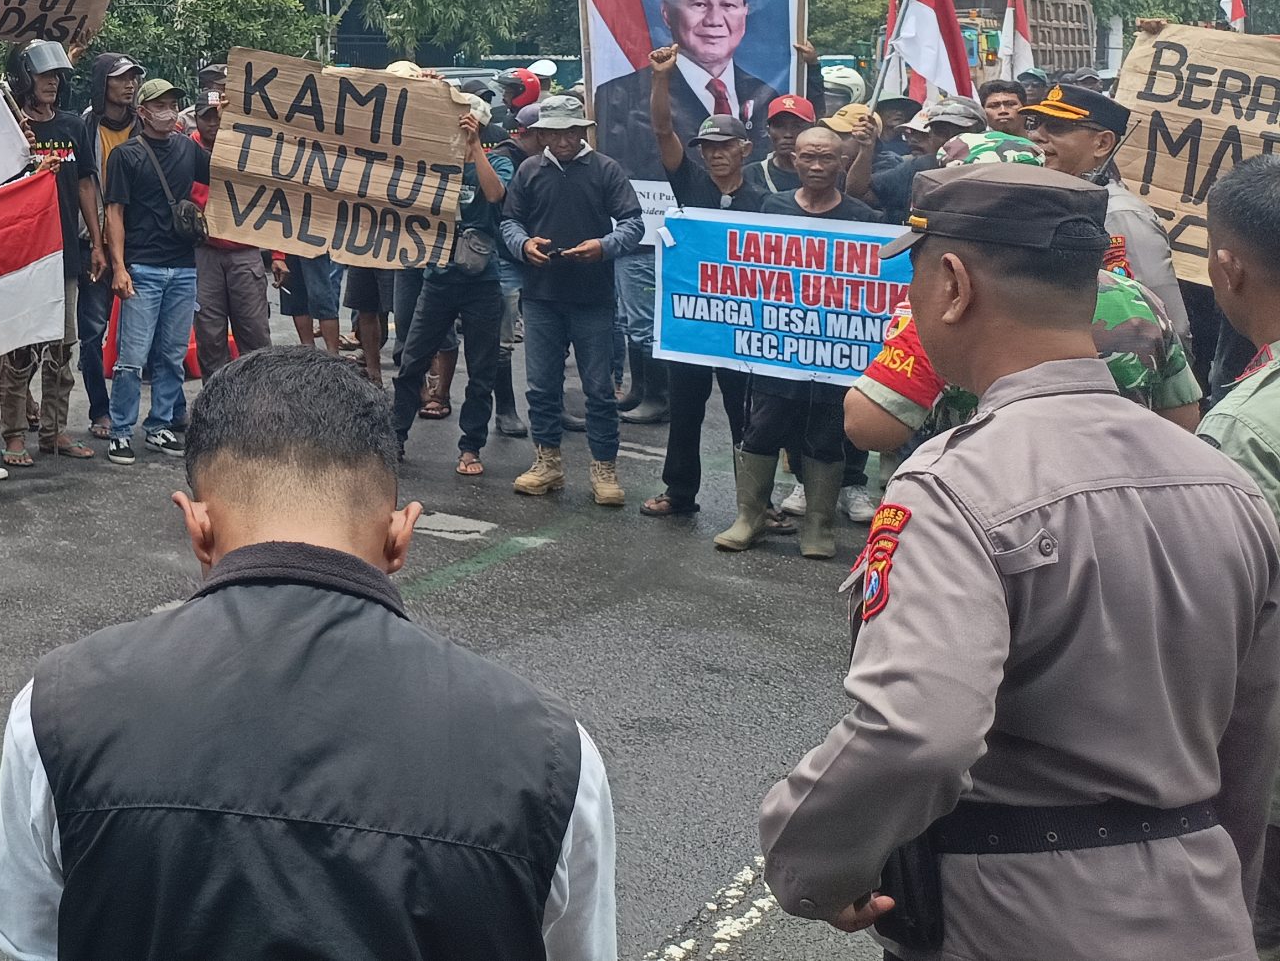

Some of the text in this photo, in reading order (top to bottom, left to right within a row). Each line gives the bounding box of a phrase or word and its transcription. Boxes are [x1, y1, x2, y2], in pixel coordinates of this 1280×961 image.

[243, 61, 409, 147] KAMI
[232, 122, 462, 216] TUNTUT
[224, 180, 448, 267] VALIDASI
[727, 229, 882, 277] LAHAN INI
[672, 294, 754, 327] WARGA
[762, 305, 821, 337] DESA
[699, 261, 910, 315] HANYA UNTUK
